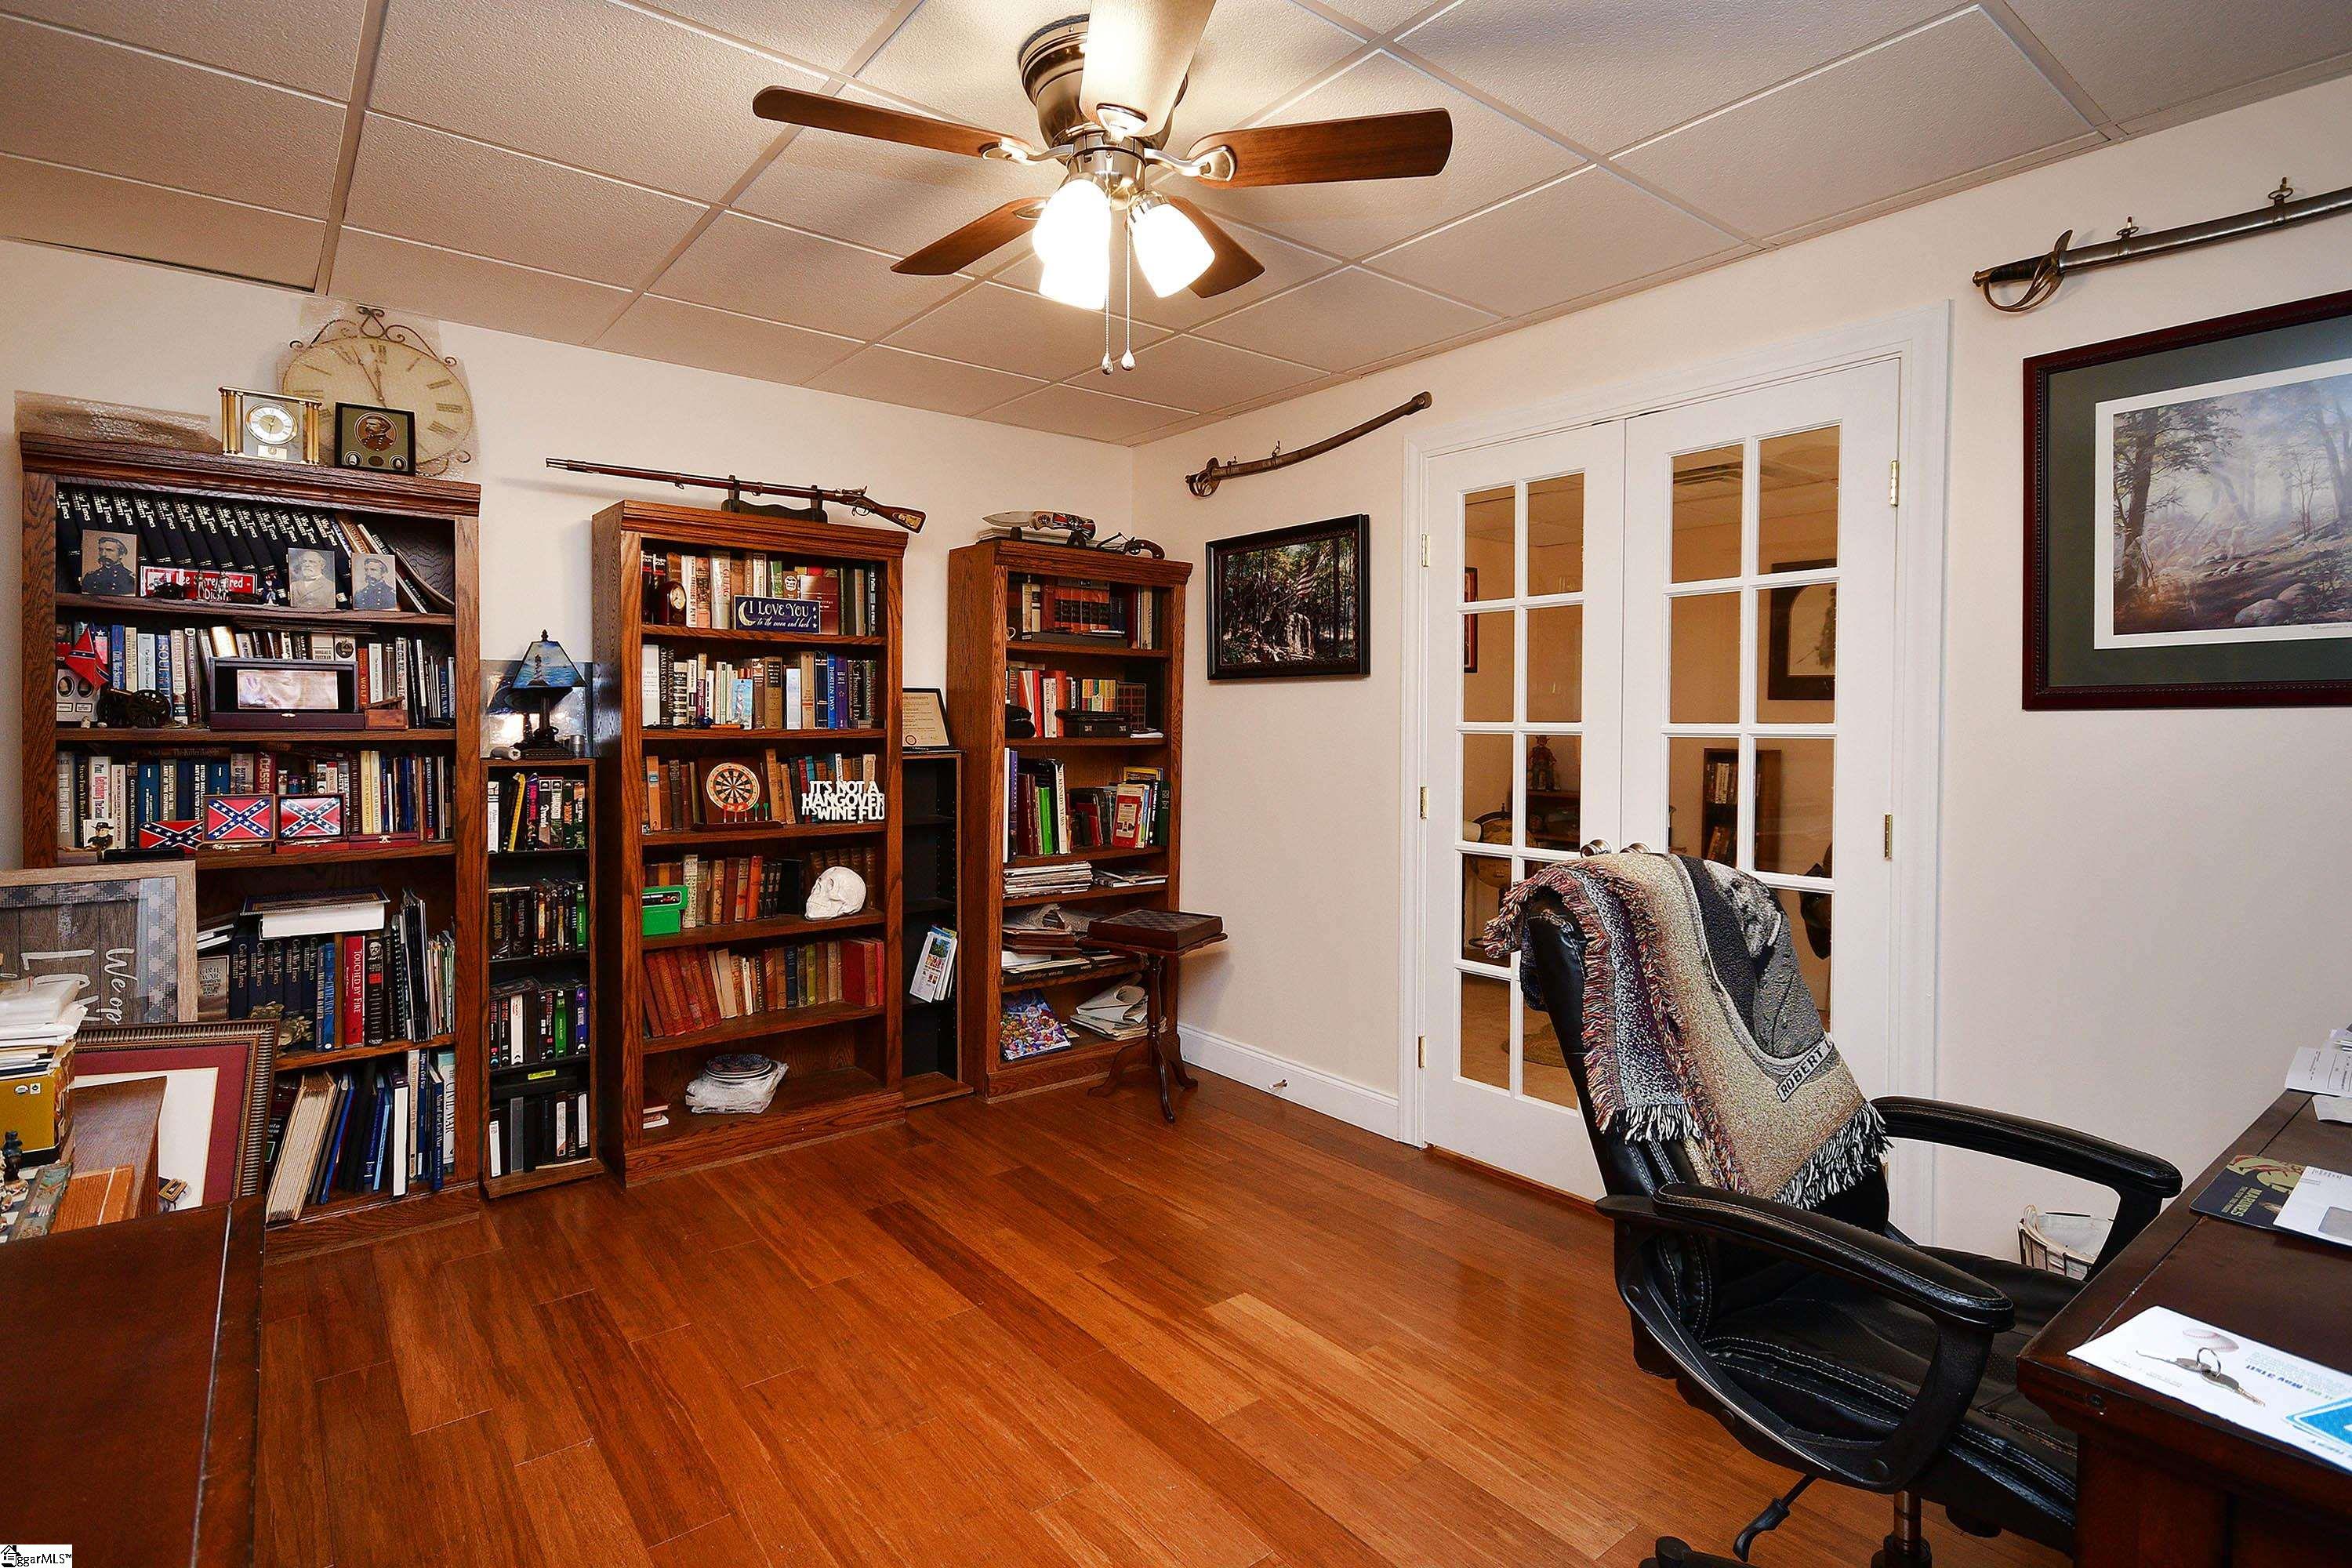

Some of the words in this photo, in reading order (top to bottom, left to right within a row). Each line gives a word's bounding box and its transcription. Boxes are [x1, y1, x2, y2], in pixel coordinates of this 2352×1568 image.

[59, 500, 73, 520] Times
[80, 502, 94, 521] Times
[101, 504, 116, 524] Times
[122, 507, 136, 526] Times
[144, 509, 158, 528] Times
[165, 511, 178, 530] Times
[184, 514, 198, 532] Times
[205, 516, 220, 534] Times
[227, 518, 240, 537] Times
[246, 520, 260, 539] Times
[266, 522, 279, 541] Times
[285, 524, 299, 543] Times
[305, 527, 318, 545] Times
[325, 528, 338, 547] Times
[749, 601, 753, 614] I
[757, 601, 785, 616] LOVE
[786, 603, 809, 617] YOU
[764, 615, 772, 627] the
[787, 617, 799, 627] and
[798, 615, 813, 628] back
[158, 644, 169, 674] SOUL
[852, 671, 862, 707] Thousand
[835, 780, 866, 794] NOT
[867, 780, 880, 794] A
[801, 793, 885, 808] HANGOVER
[817, 806, 857, 821] WINE
[858, 806, 885, 821] FLU
[273, 968, 281, 985] Times
[353, 949, 362, 985] TOUCHED
[238, 972, 247, 988] Times
[256, 969, 264, 986] Times
[353, 985, 361, 996] BY
[353, 997, 361, 1014] FIRE
[1780, 1049, 1824, 1098] ROBERT
[445, 1082, 455, 1110] CIVIL
[445, 1113, 455, 1134] WAR
[2230, 1188, 2263, 1218] MARINES
